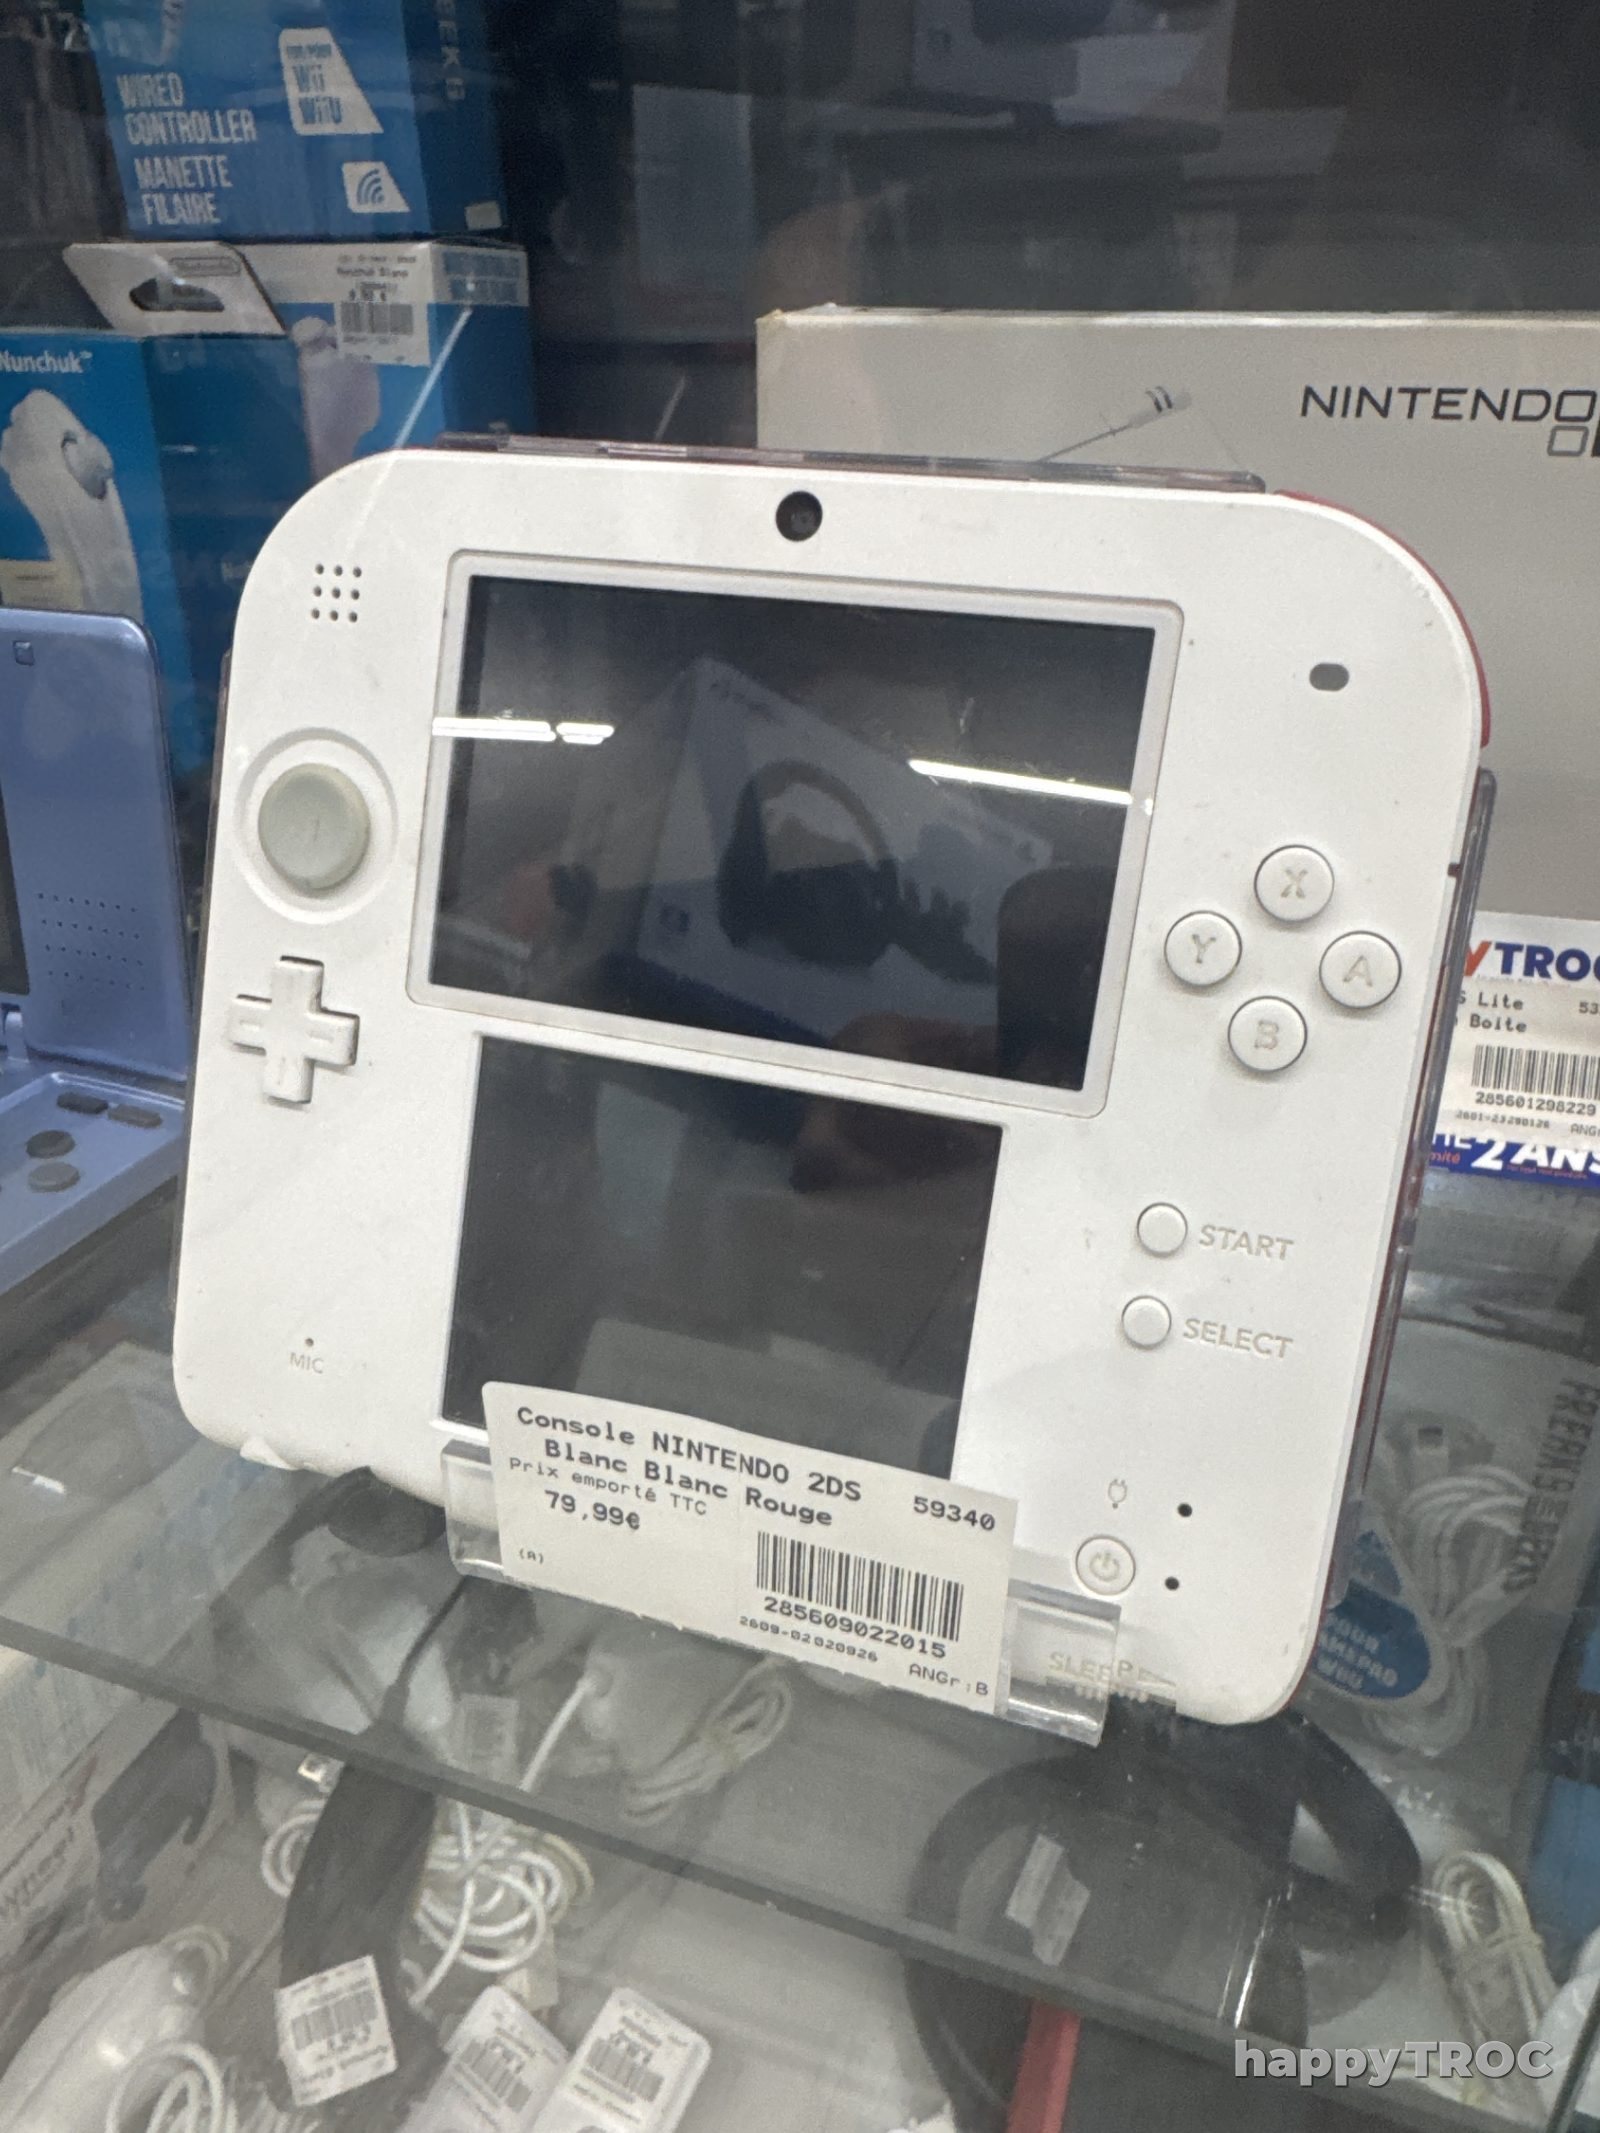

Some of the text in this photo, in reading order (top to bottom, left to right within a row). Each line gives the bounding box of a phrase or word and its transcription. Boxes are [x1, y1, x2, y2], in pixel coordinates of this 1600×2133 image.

[117, 72, 184, 108] WIRED
[124, 109, 257, 146] CONTROLLER
[134, 155, 233, 190] MANETTE
[141, 192, 221, 226] FILAIRE
[1300, 384, 1598, 423] NINTENDO
[1280, 868, 1308, 899] X
[1191, 933, 1217, 964] Y
[1464, 940, 1600, 982] TRO
[1342, 954, 1373, 988] A
[1477, 991, 1524, 1010] Lite
[1578, 1001, 1600, 1015] 53
[1254, 1020, 1280, 1050] B
[1475, 1091, 1597, 1117] 285601298229
[1198, 1224, 1294, 1261] START
[1182, 1317, 1294, 1359] SELECT
[290, 1351, 324, 1374] MIC
[509, 1457, 708, 1516] Prix emporté TTC
[516, 1406, 996, 1531] Console NINTENDO 2DS 59340
[544, 1438, 833, 1526] Blanc Blanc Rouge
[544, 1489, 641, 1531] 79,99€
[764, 1595, 946, 1659] 285609022015
